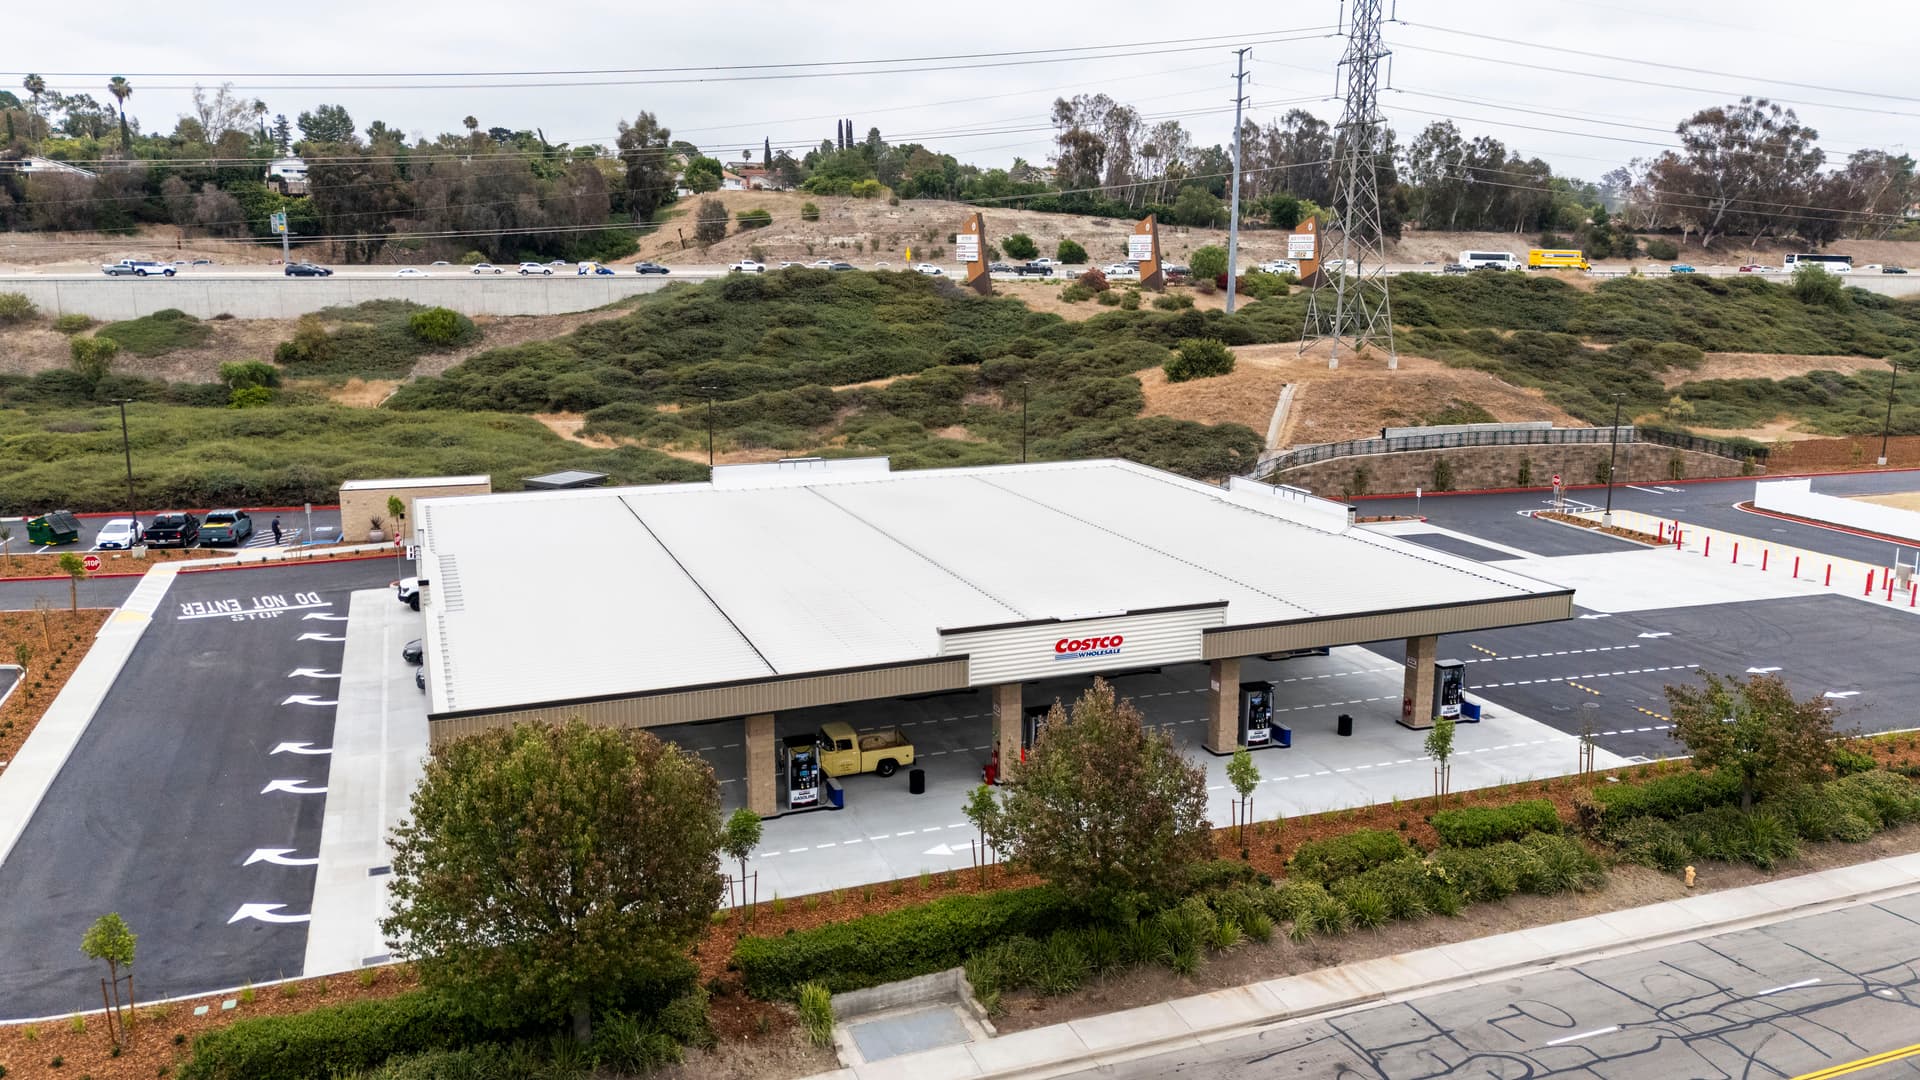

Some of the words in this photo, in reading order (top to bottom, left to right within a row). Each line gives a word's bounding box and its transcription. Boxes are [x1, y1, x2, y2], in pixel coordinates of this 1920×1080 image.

[252, 594, 288, 610] NOT
[295, 591, 322, 605] DO
[180, 598, 242, 616] ENTER
[230, 610, 284, 621] STOP
[1055, 635, 1124, 653] COSTCO
[1078, 648, 1121, 658] WHOLESALE
